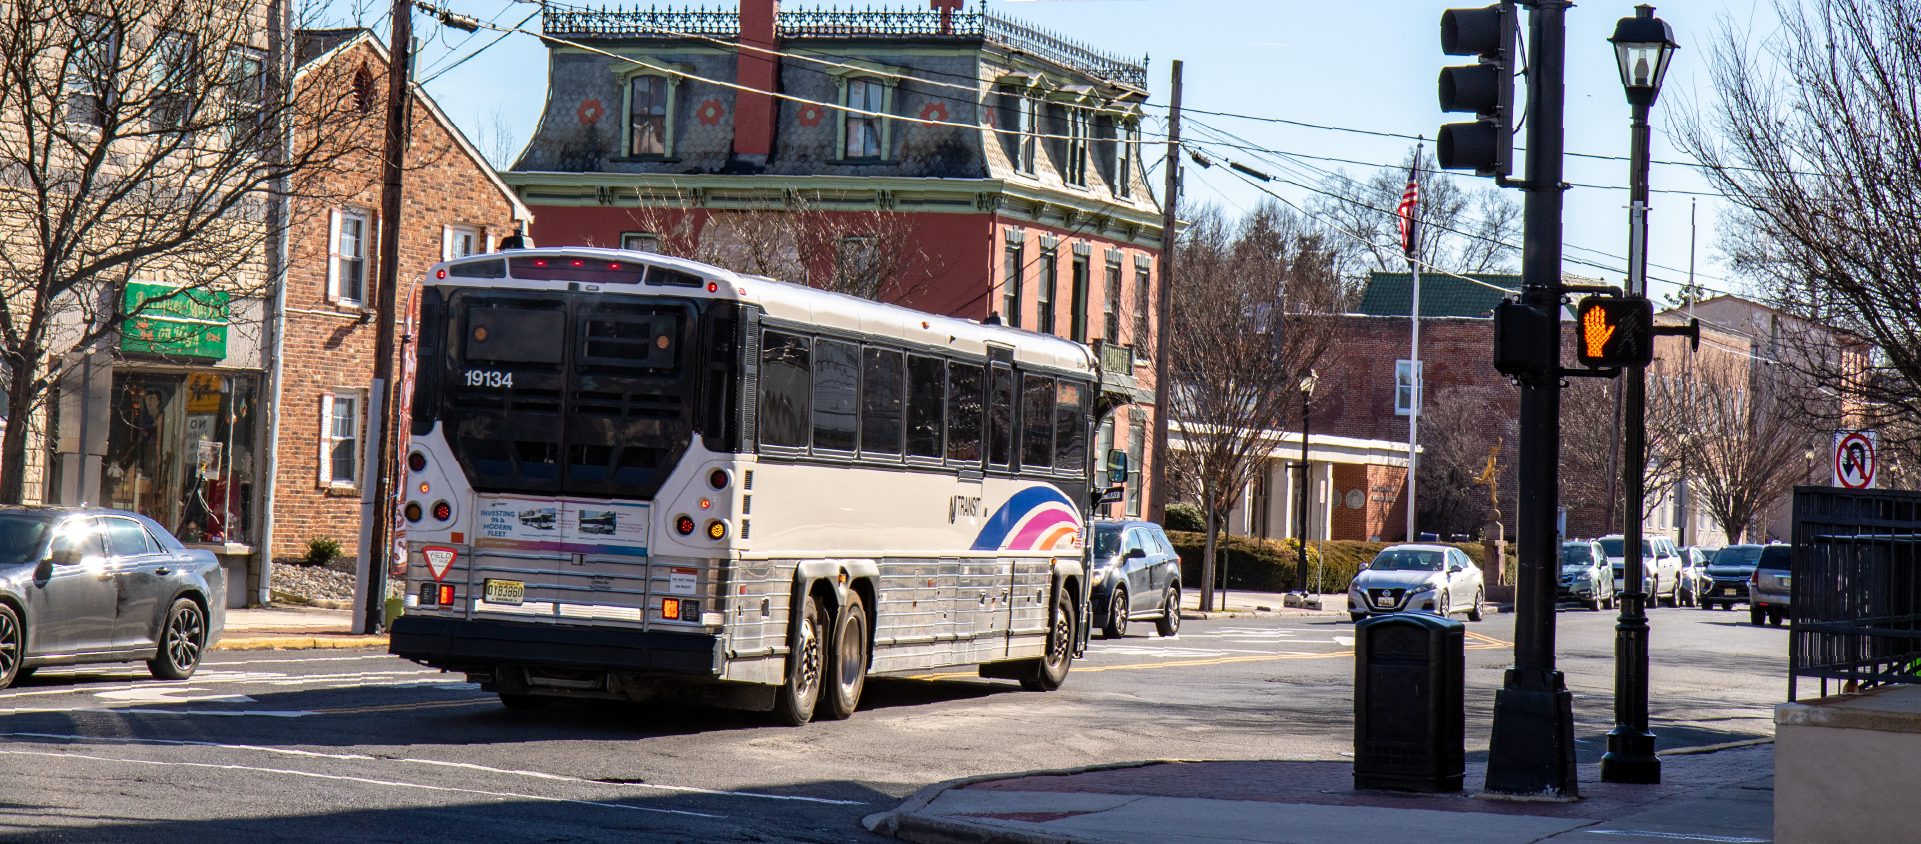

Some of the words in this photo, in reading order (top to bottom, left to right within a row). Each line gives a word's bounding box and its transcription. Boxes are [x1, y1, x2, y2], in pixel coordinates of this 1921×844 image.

[465, 369, 513, 389] 19134
[957, 495, 981, 518] TRANSIT
[480, 509, 515, 518] INVESTING
[482, 523, 513, 531] MODERN
[428, 551, 452, 559] YIELD
